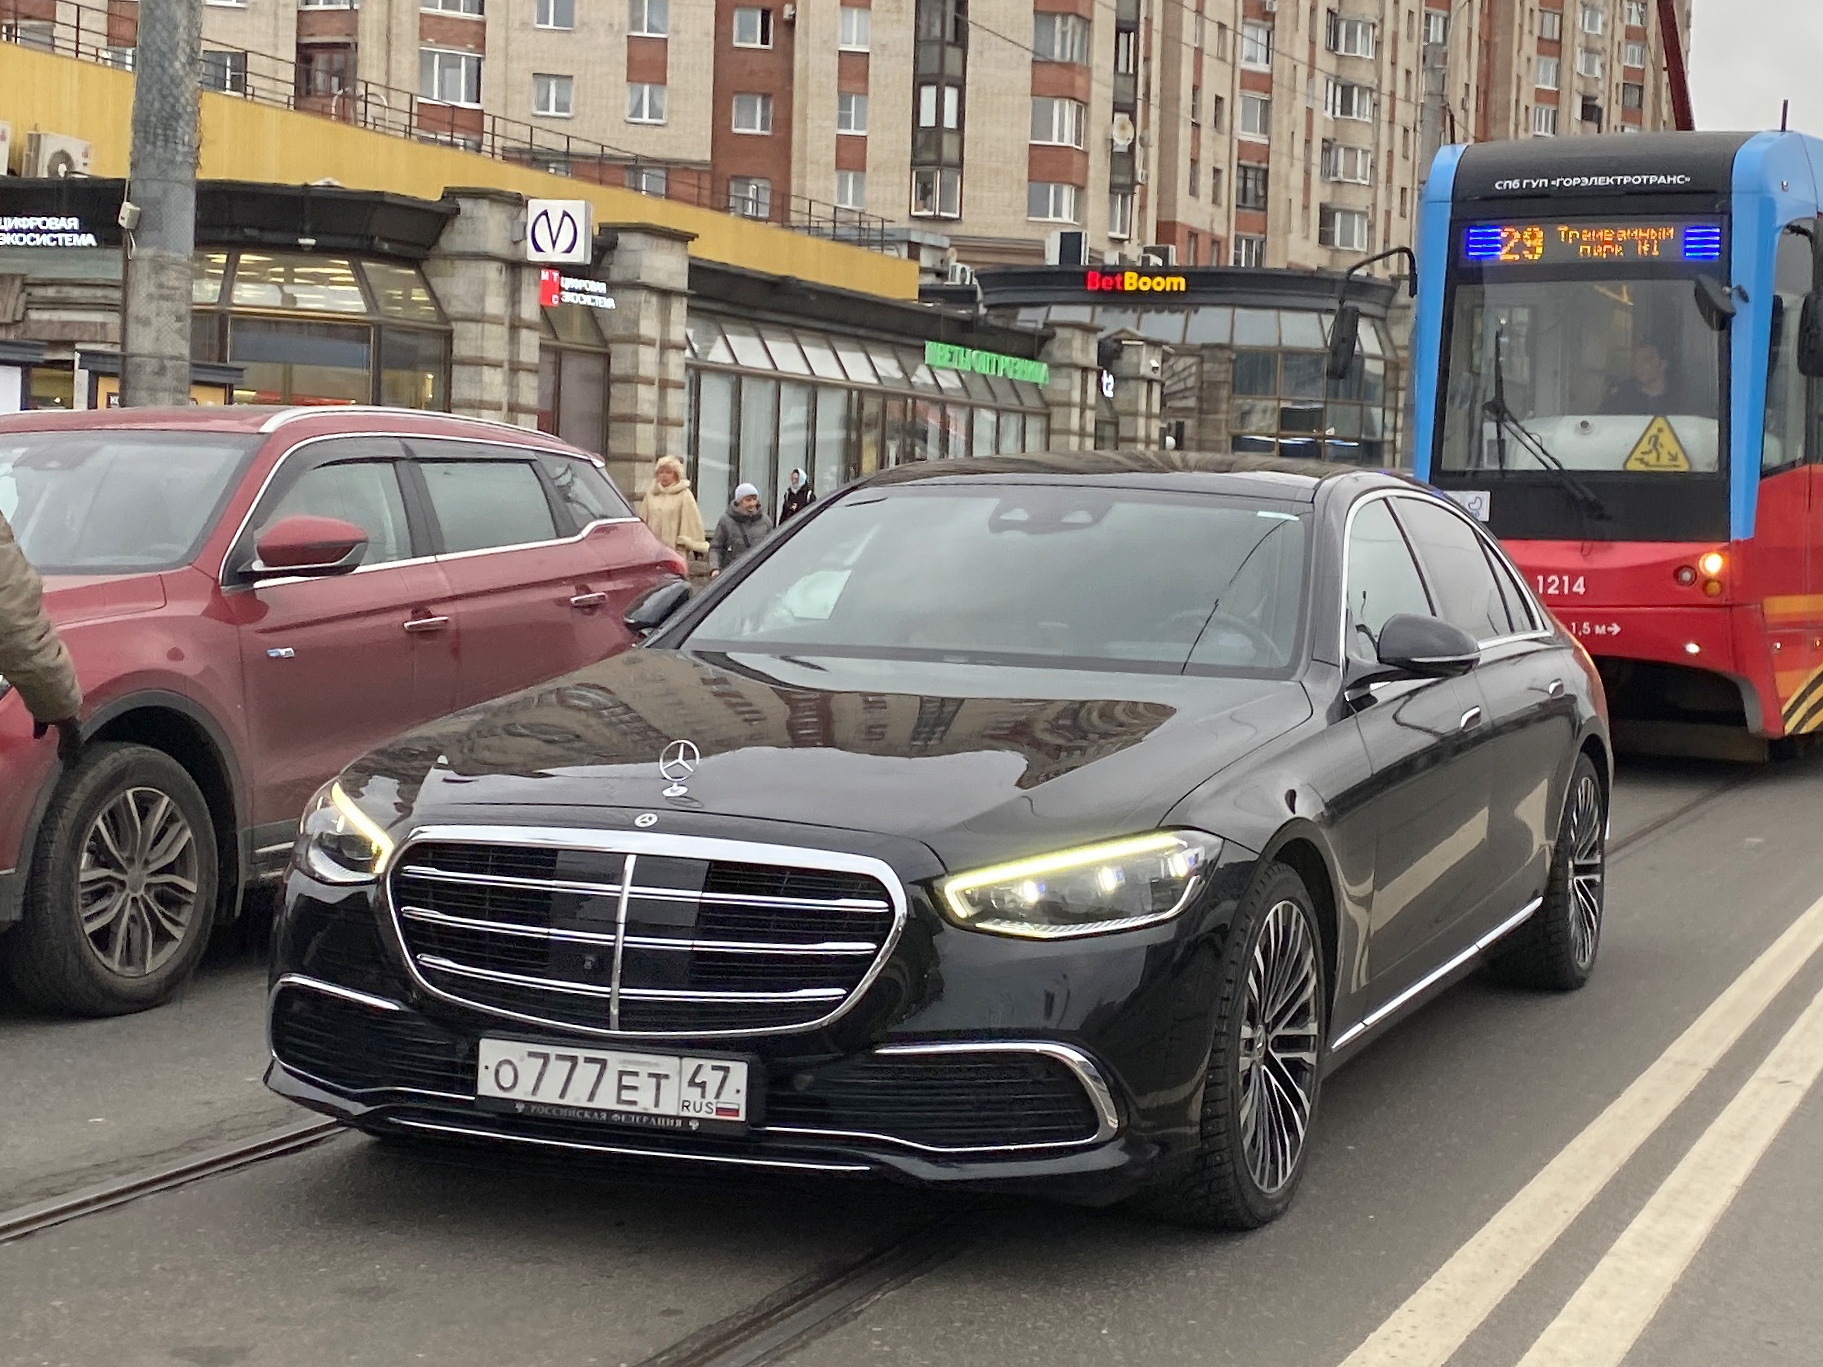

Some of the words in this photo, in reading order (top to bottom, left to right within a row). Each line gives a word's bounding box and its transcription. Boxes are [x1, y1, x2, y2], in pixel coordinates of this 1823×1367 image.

[1522, 178, 1548, 189] ГУП
[0, 216, 80, 231] ЦИФРОВАЯ
[0, 232, 98, 247] ЭКОСИСТЕМА
[1499, 226, 1545, 261] 29
[1579, 241, 1624, 258] парк
[1086, 270, 1186, 292] BetBoom
[1536, 575, 1586, 595] 1214
[1571, 621, 1591, 636] 1,5
[687, 1063, 731, 1100] 47
[681, 1099, 714, 1115] RUS
[530, 1104, 608, 1122] РОССИЙСКАЯ
[612, 1110, 683, 1129] ФЕДЕРАЦИЯ
